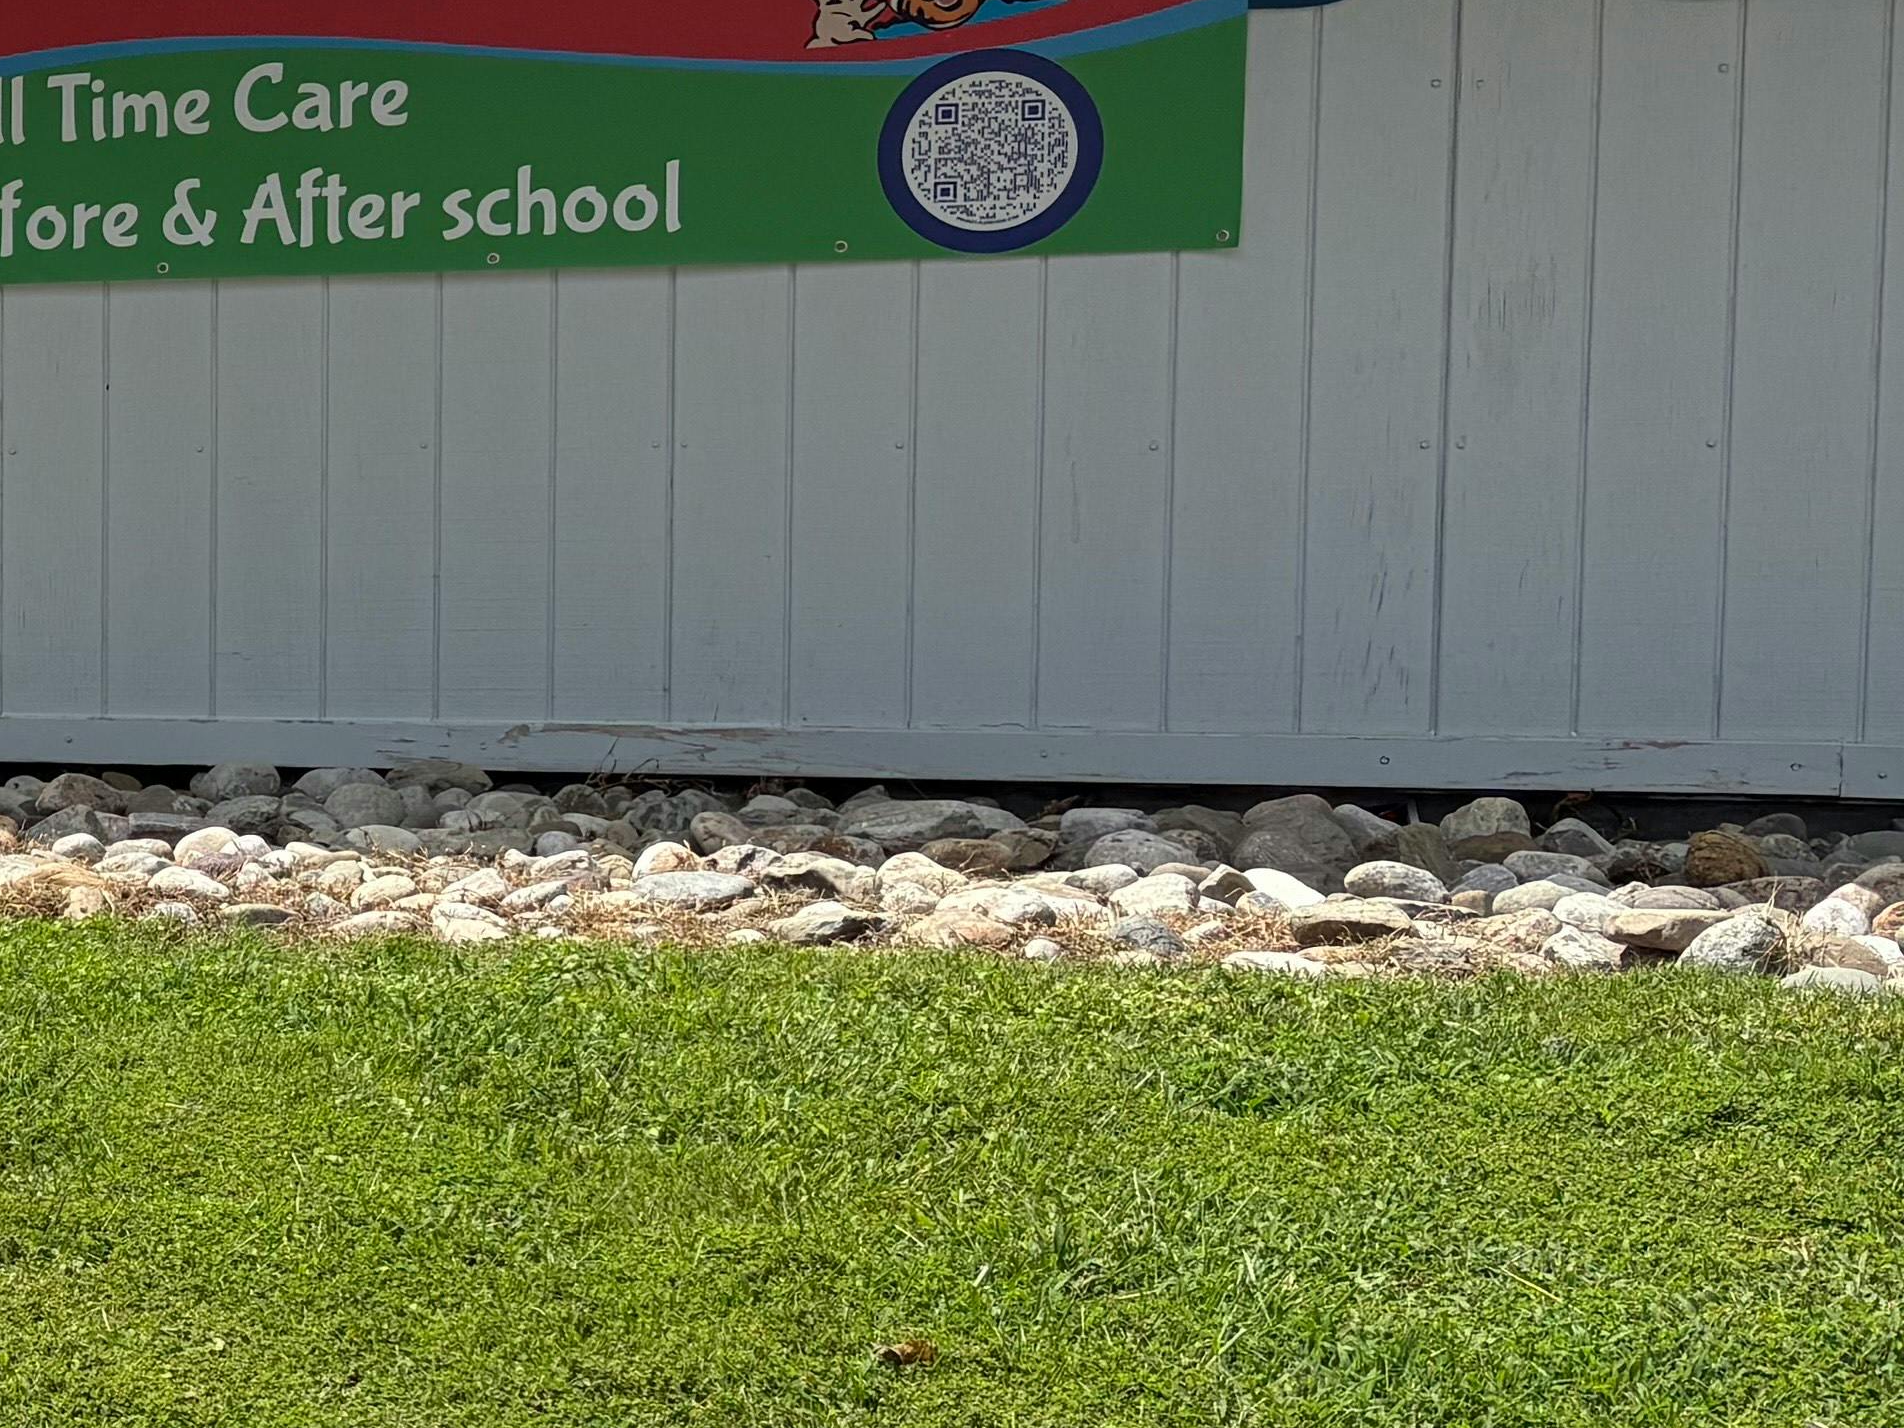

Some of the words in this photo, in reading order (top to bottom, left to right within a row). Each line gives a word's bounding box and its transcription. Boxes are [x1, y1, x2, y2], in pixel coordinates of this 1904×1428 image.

[48, 73, 209, 141] Time
[235, 63, 408, 131] Care
[163, 179, 216, 246] &
[241, 168, 420, 247] After
[443, 160, 681, 240] school
